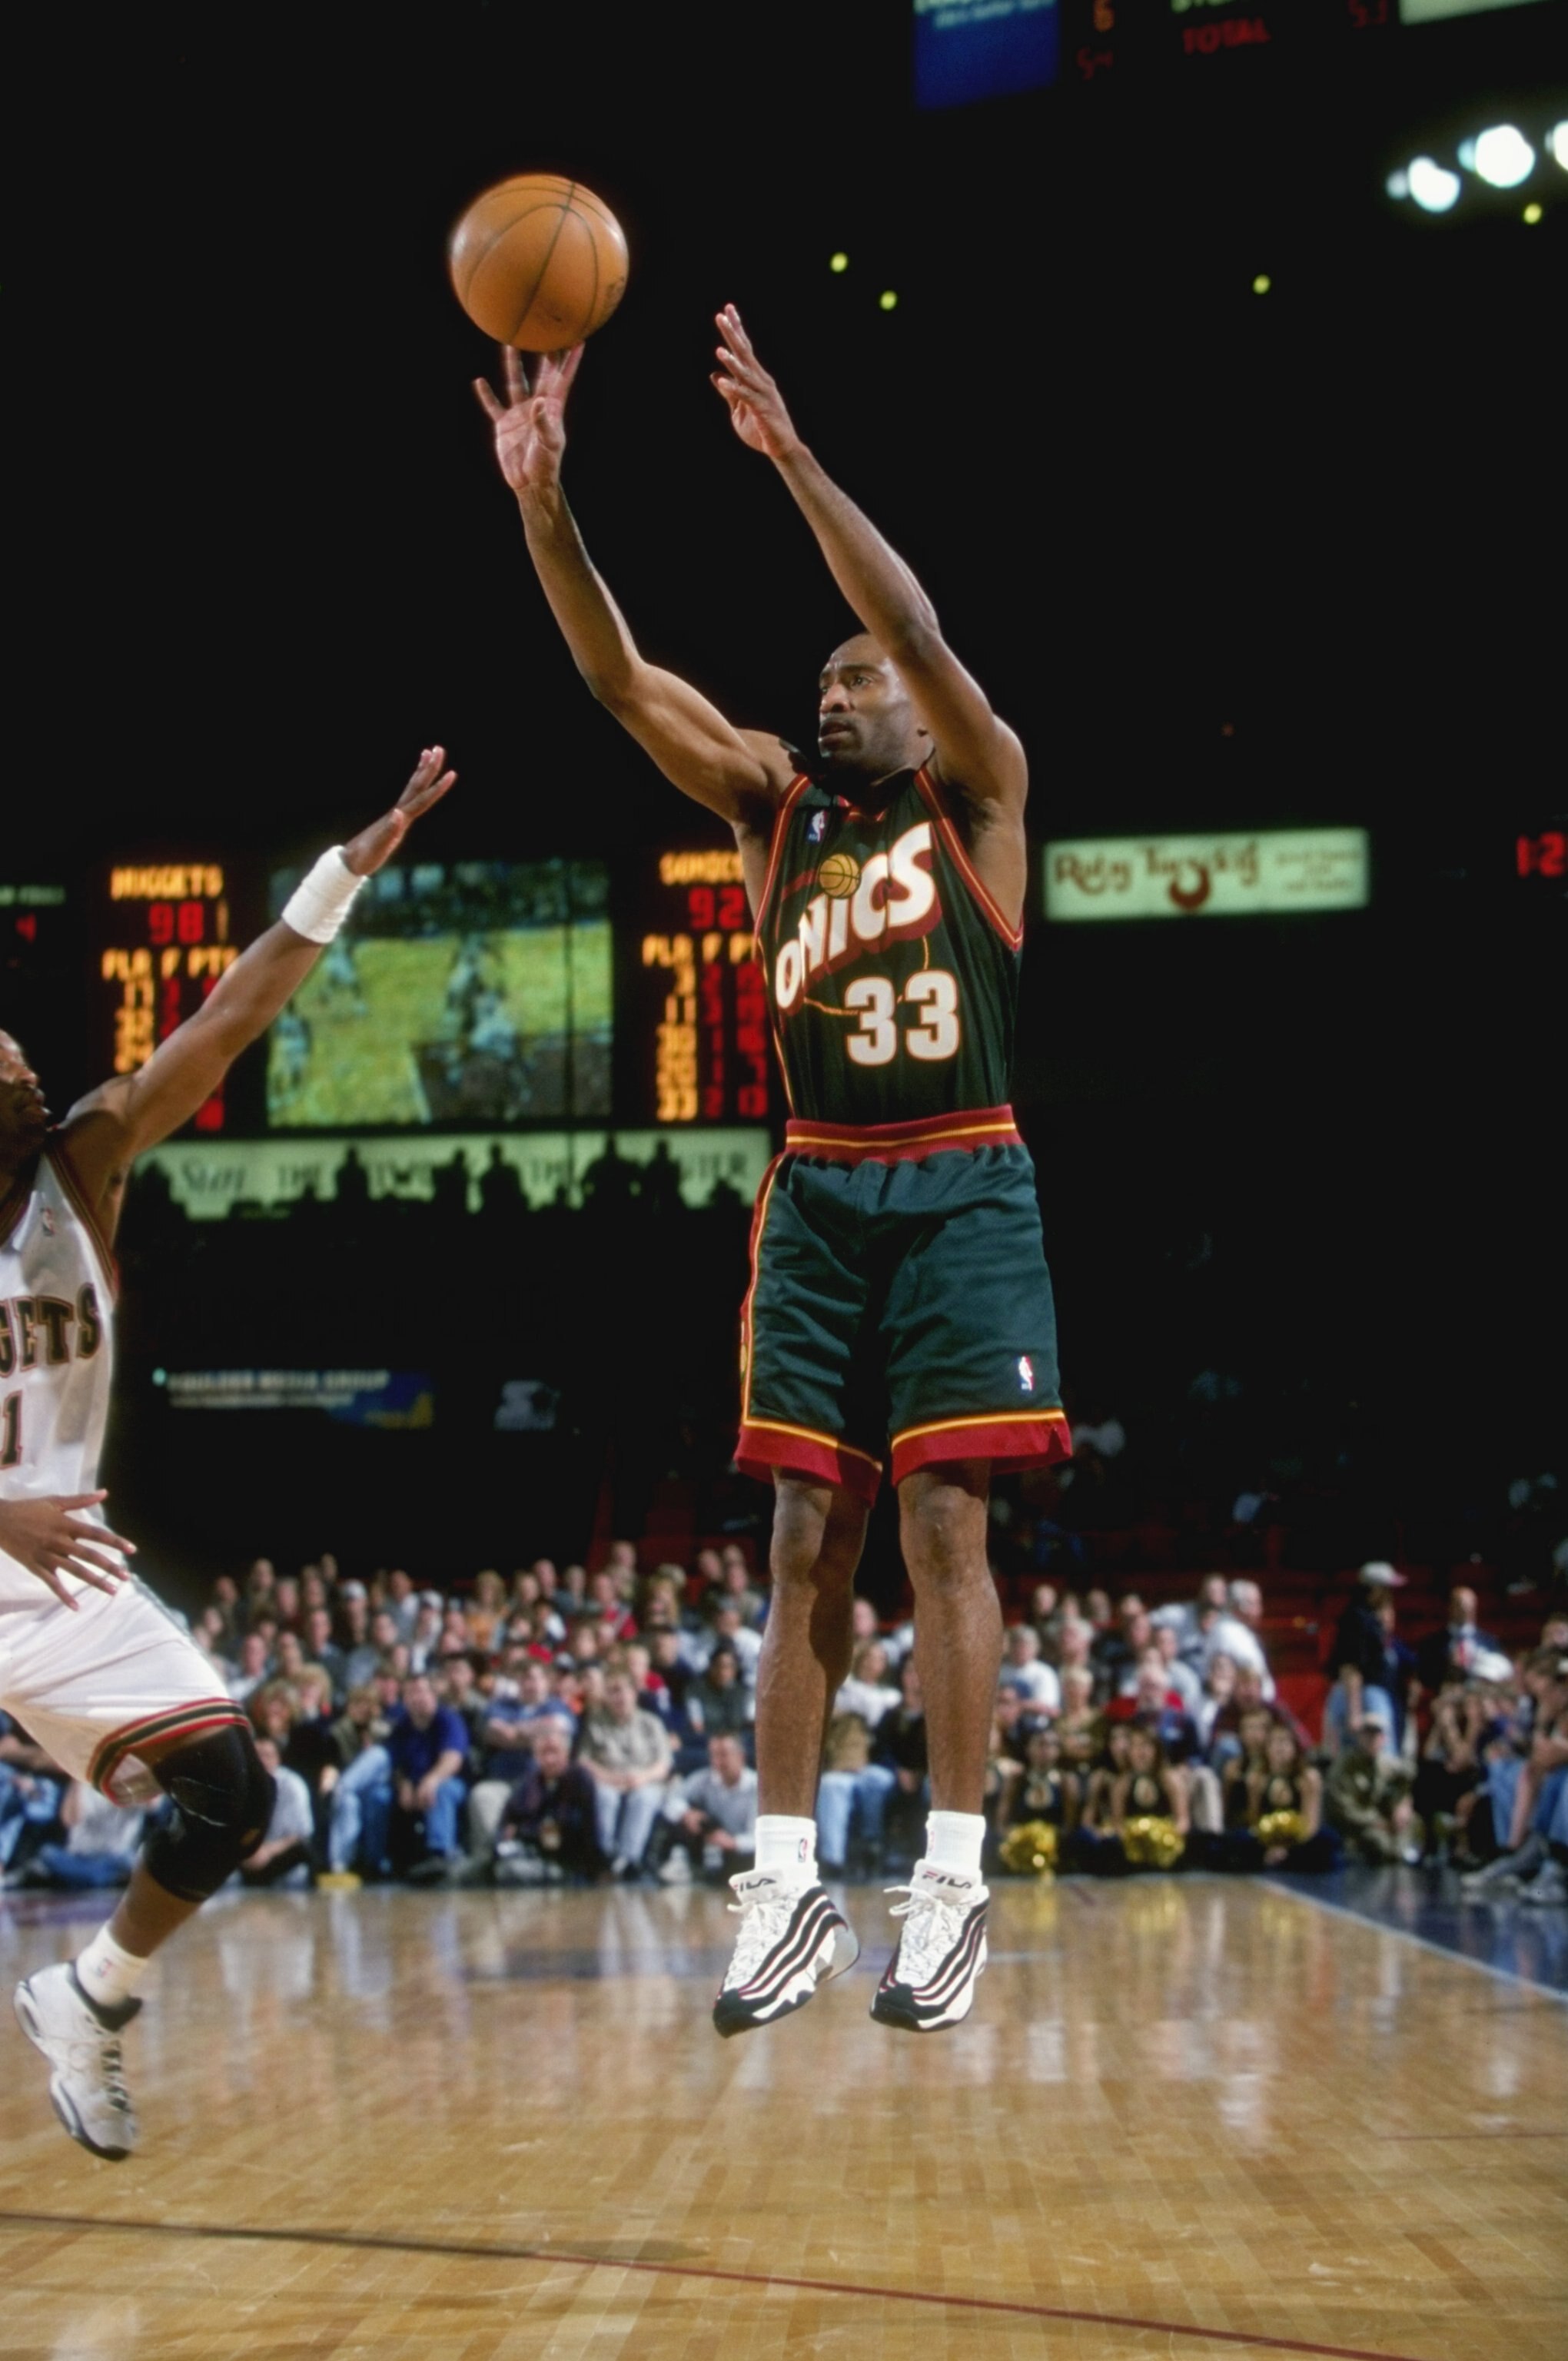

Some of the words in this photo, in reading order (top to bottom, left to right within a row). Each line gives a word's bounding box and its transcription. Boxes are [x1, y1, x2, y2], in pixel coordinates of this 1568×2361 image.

[1182, 16, 1272, 55] TOTAL
[688, 885, 745, 930] 92
[846, 971, 959, 1065] 33
[922, 1870, 972, 1889] FILA
